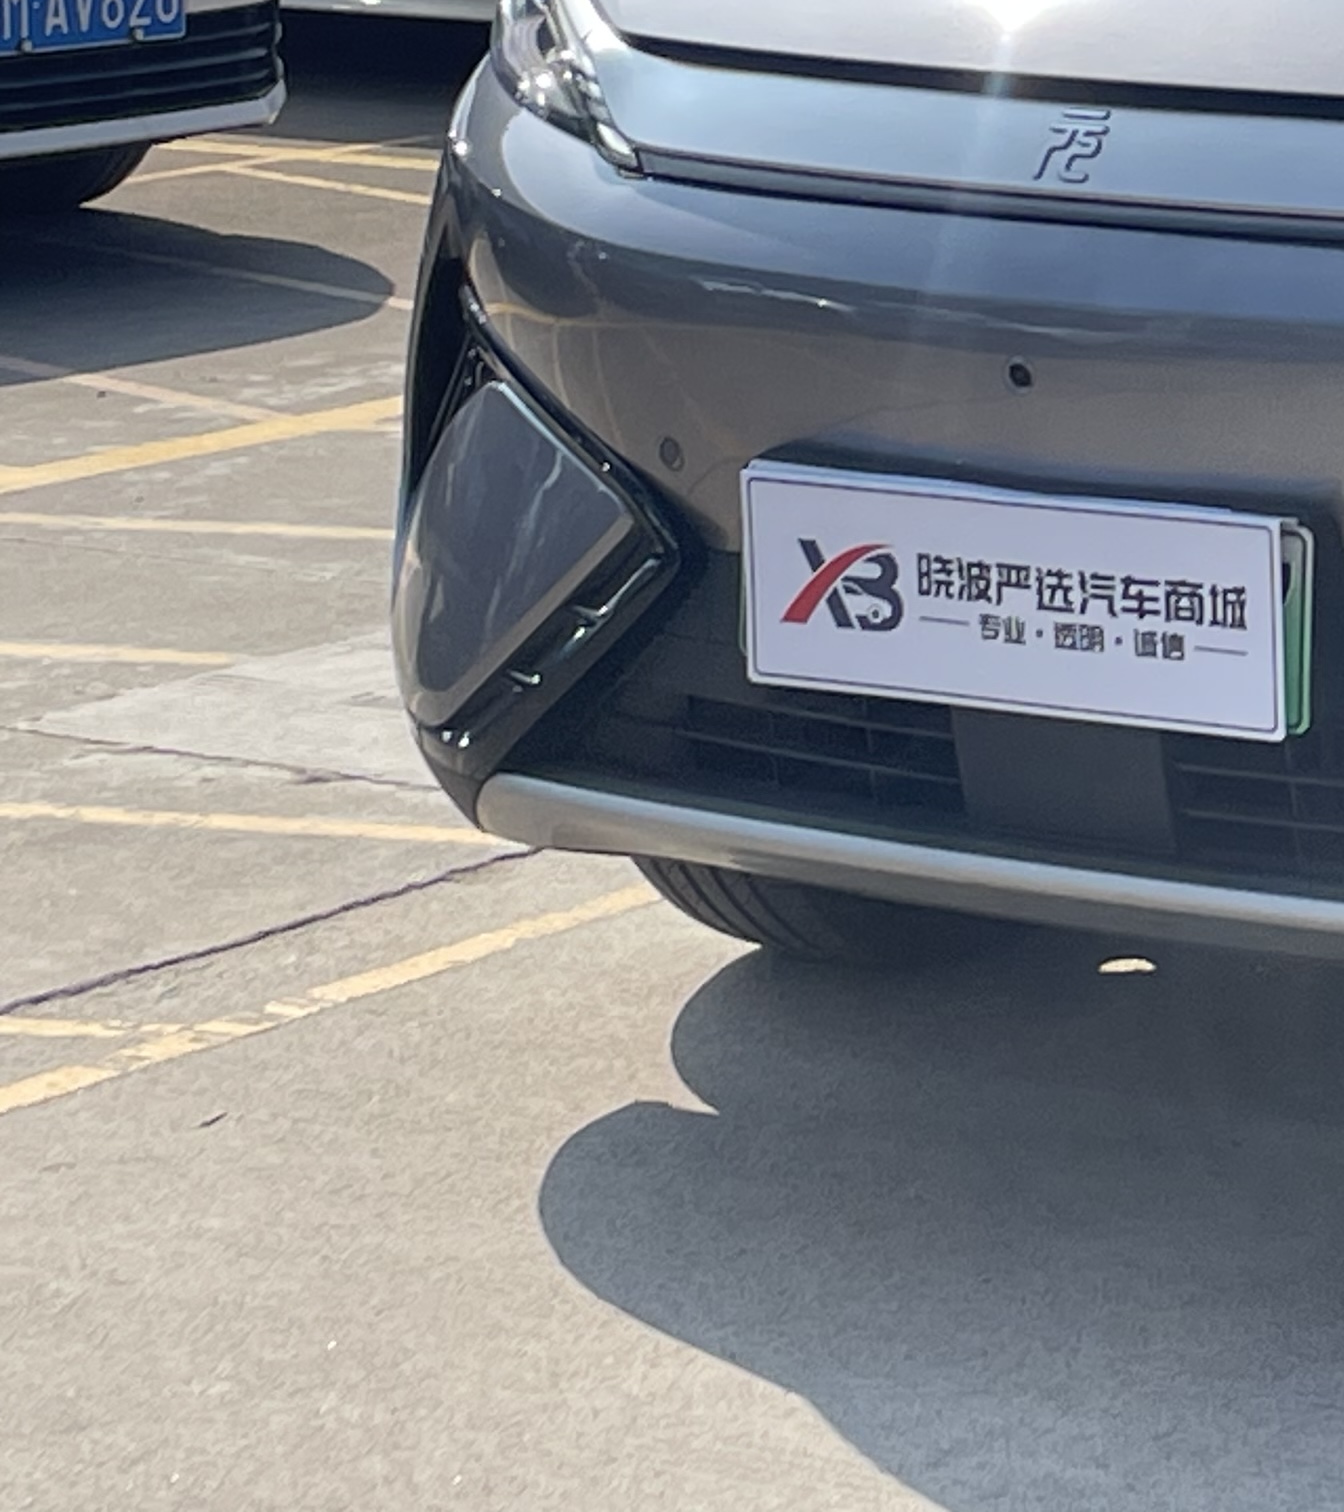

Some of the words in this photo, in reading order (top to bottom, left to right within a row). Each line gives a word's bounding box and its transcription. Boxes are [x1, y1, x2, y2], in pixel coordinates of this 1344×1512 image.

[915, 551, 1248, 632] 晓波严选汽车商城
